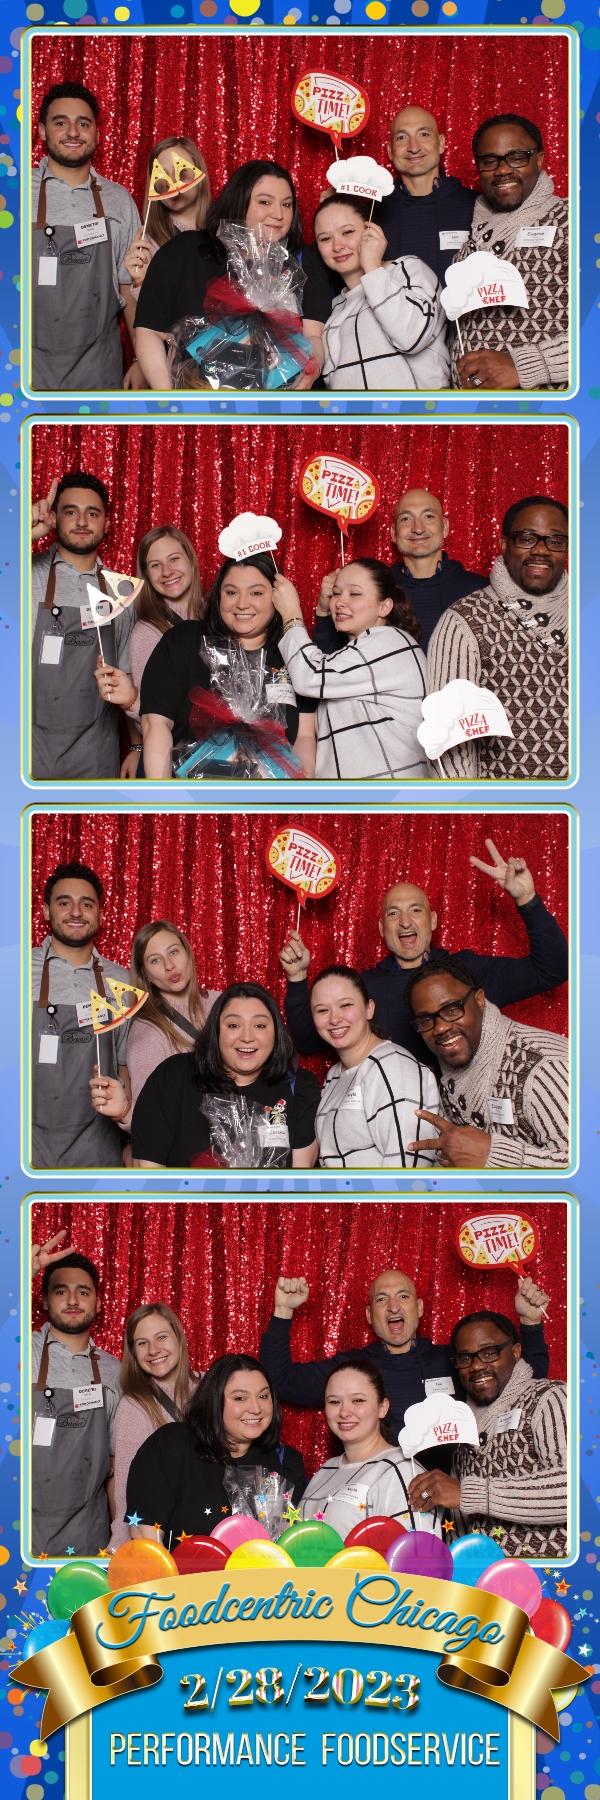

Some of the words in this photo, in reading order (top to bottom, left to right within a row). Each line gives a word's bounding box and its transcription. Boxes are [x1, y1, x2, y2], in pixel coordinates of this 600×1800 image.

[317, 98, 351, 120] TIME!
[340, 184, 350, 192] #1
[353, 185, 378, 197] COOK
[477, 282, 505, 297] PIZZA
[482, 295, 506, 305] CHEF
[325, 482, 360, 506] TIME!
[247, 540, 271, 553] COOK
[458, 712, 488, 730] PIZZA
[465, 725, 490, 738] CHEF
[289, 854, 322, 881] TIME!
[482, 1231, 520, 1254] TIME!
[433, 1422, 458, 1437] PIZZA
[436, 1433, 460, 1443] CHEF
